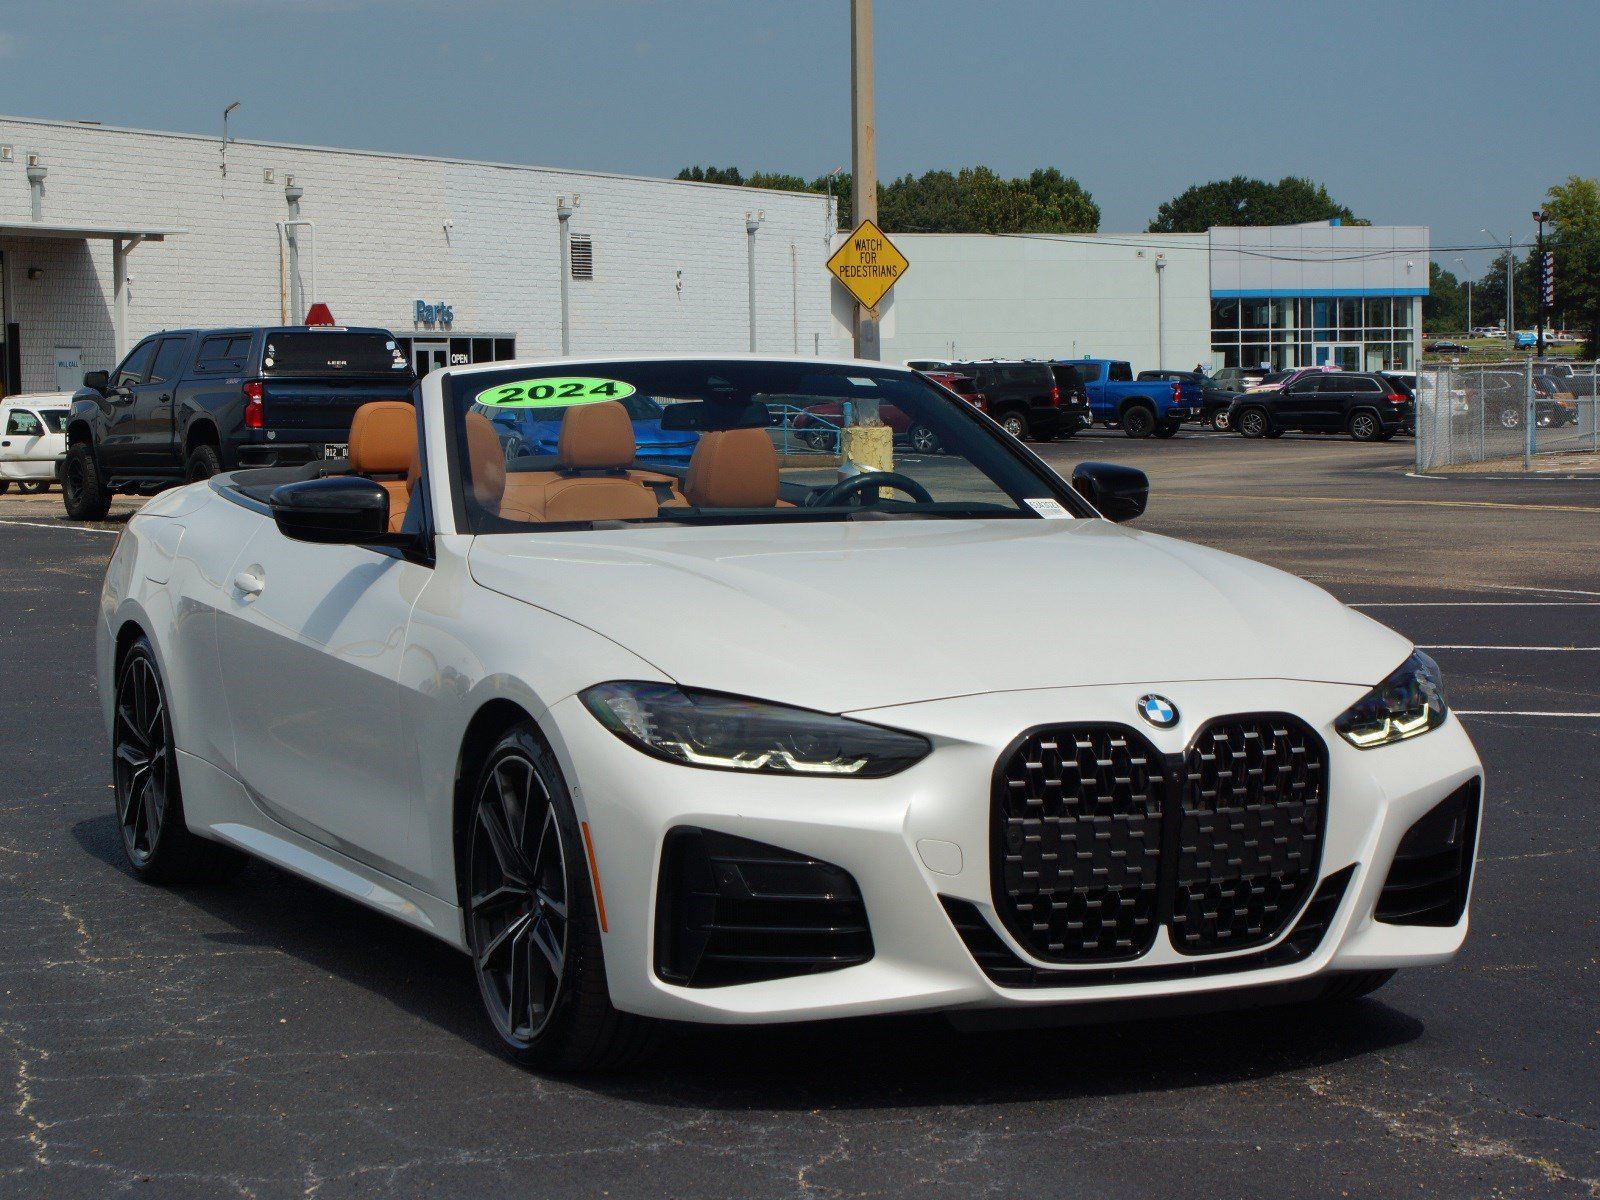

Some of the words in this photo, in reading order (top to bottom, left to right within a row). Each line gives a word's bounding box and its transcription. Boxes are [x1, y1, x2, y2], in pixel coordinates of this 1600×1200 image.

[855, 239, 882, 251] WATCH
[860, 252, 877, 263] FOR
[839, 265, 898, 278] PEDESTRIANS
[413, 299, 454, 324] Parts
[451, 353, 468, 364] OPEN
[496, 380, 619, 404] 2024
